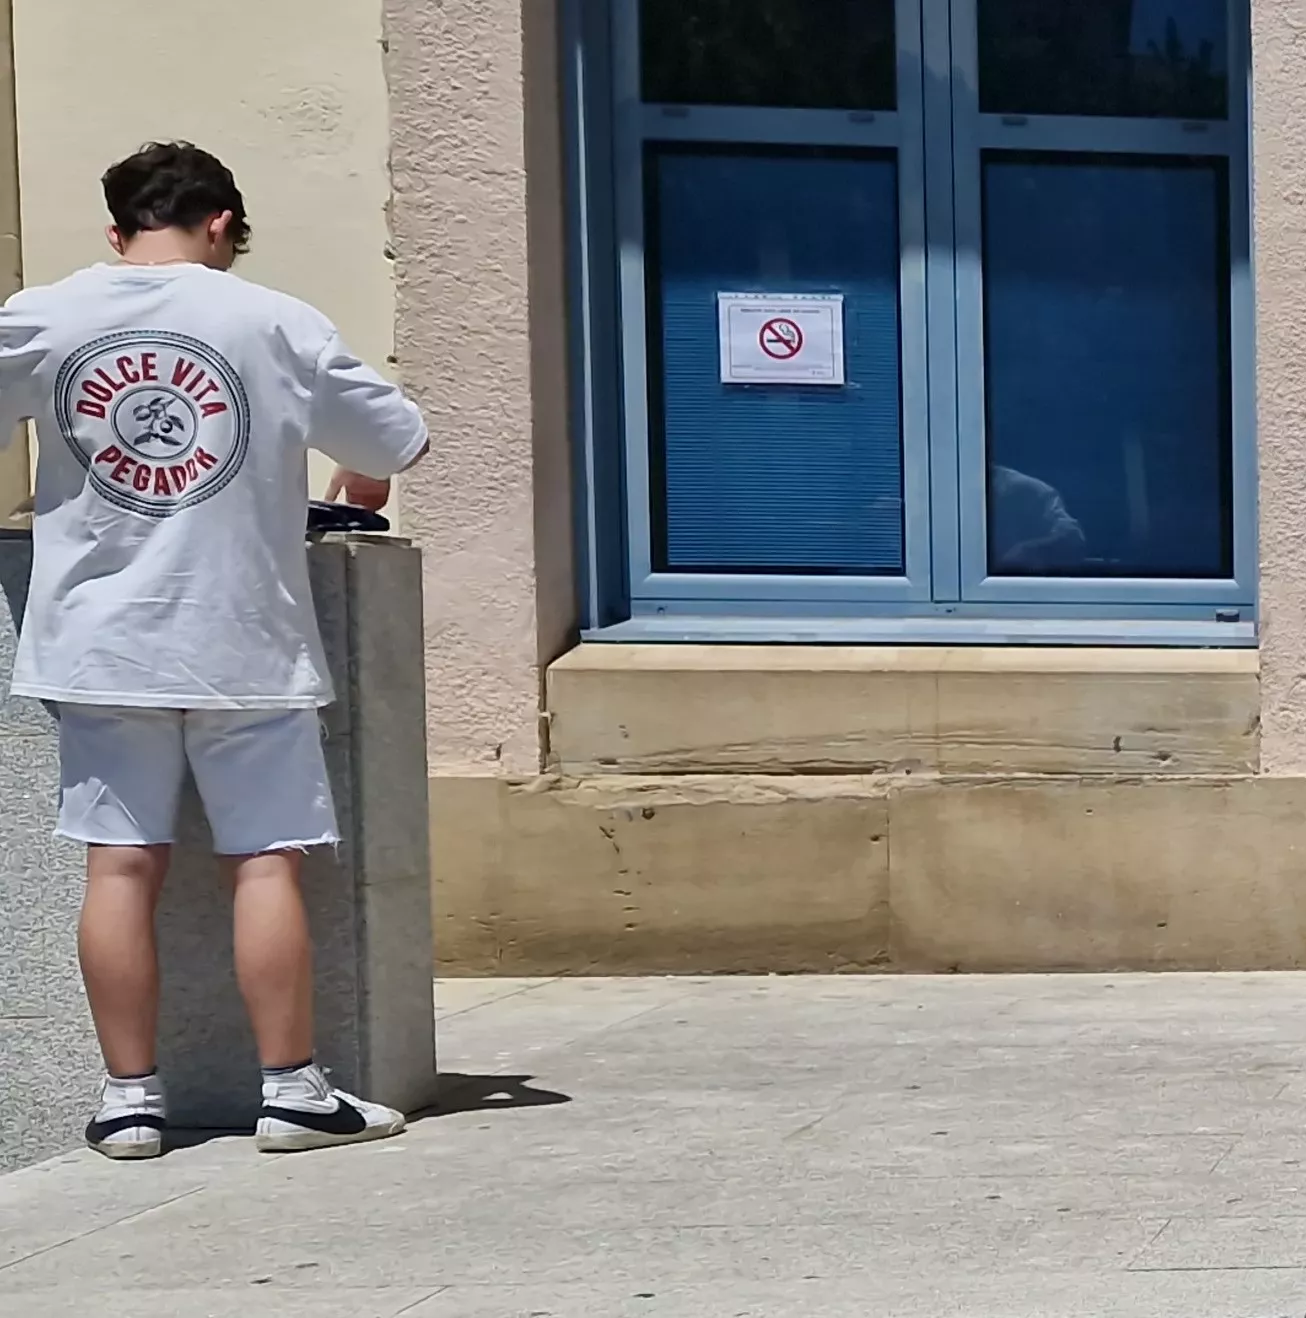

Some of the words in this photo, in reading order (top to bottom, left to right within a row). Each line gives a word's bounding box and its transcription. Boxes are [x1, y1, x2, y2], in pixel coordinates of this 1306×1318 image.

[76, 352, 158, 420] DOLCE
[171, 356, 228, 419] VITA
[94, 444, 219, 496] PEGADOR
